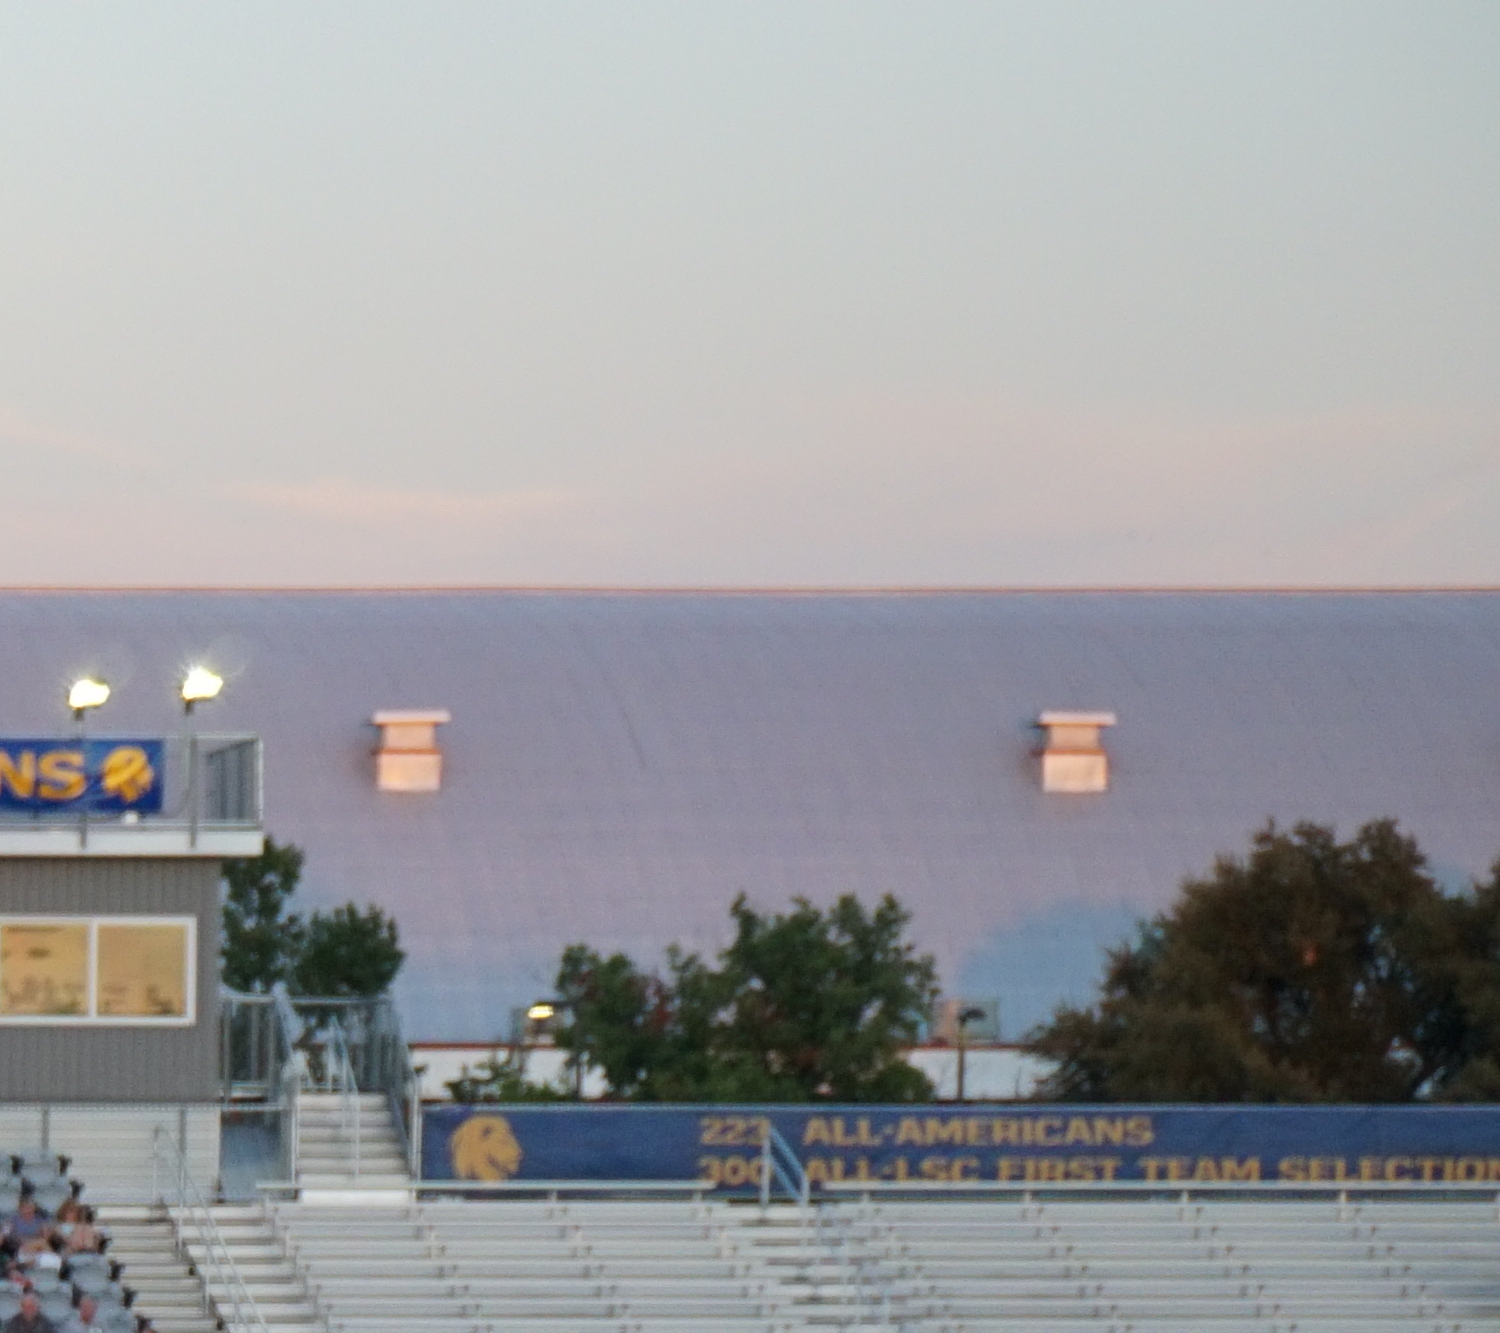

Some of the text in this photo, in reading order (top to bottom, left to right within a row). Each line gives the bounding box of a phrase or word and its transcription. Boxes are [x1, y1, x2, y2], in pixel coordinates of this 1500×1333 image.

[803, 1115, 1155, 1148] ALL-AMERICANS
[997, 1156, 1122, 1182] FIRST
[1137, 1156, 1262, 1182] TEAM
